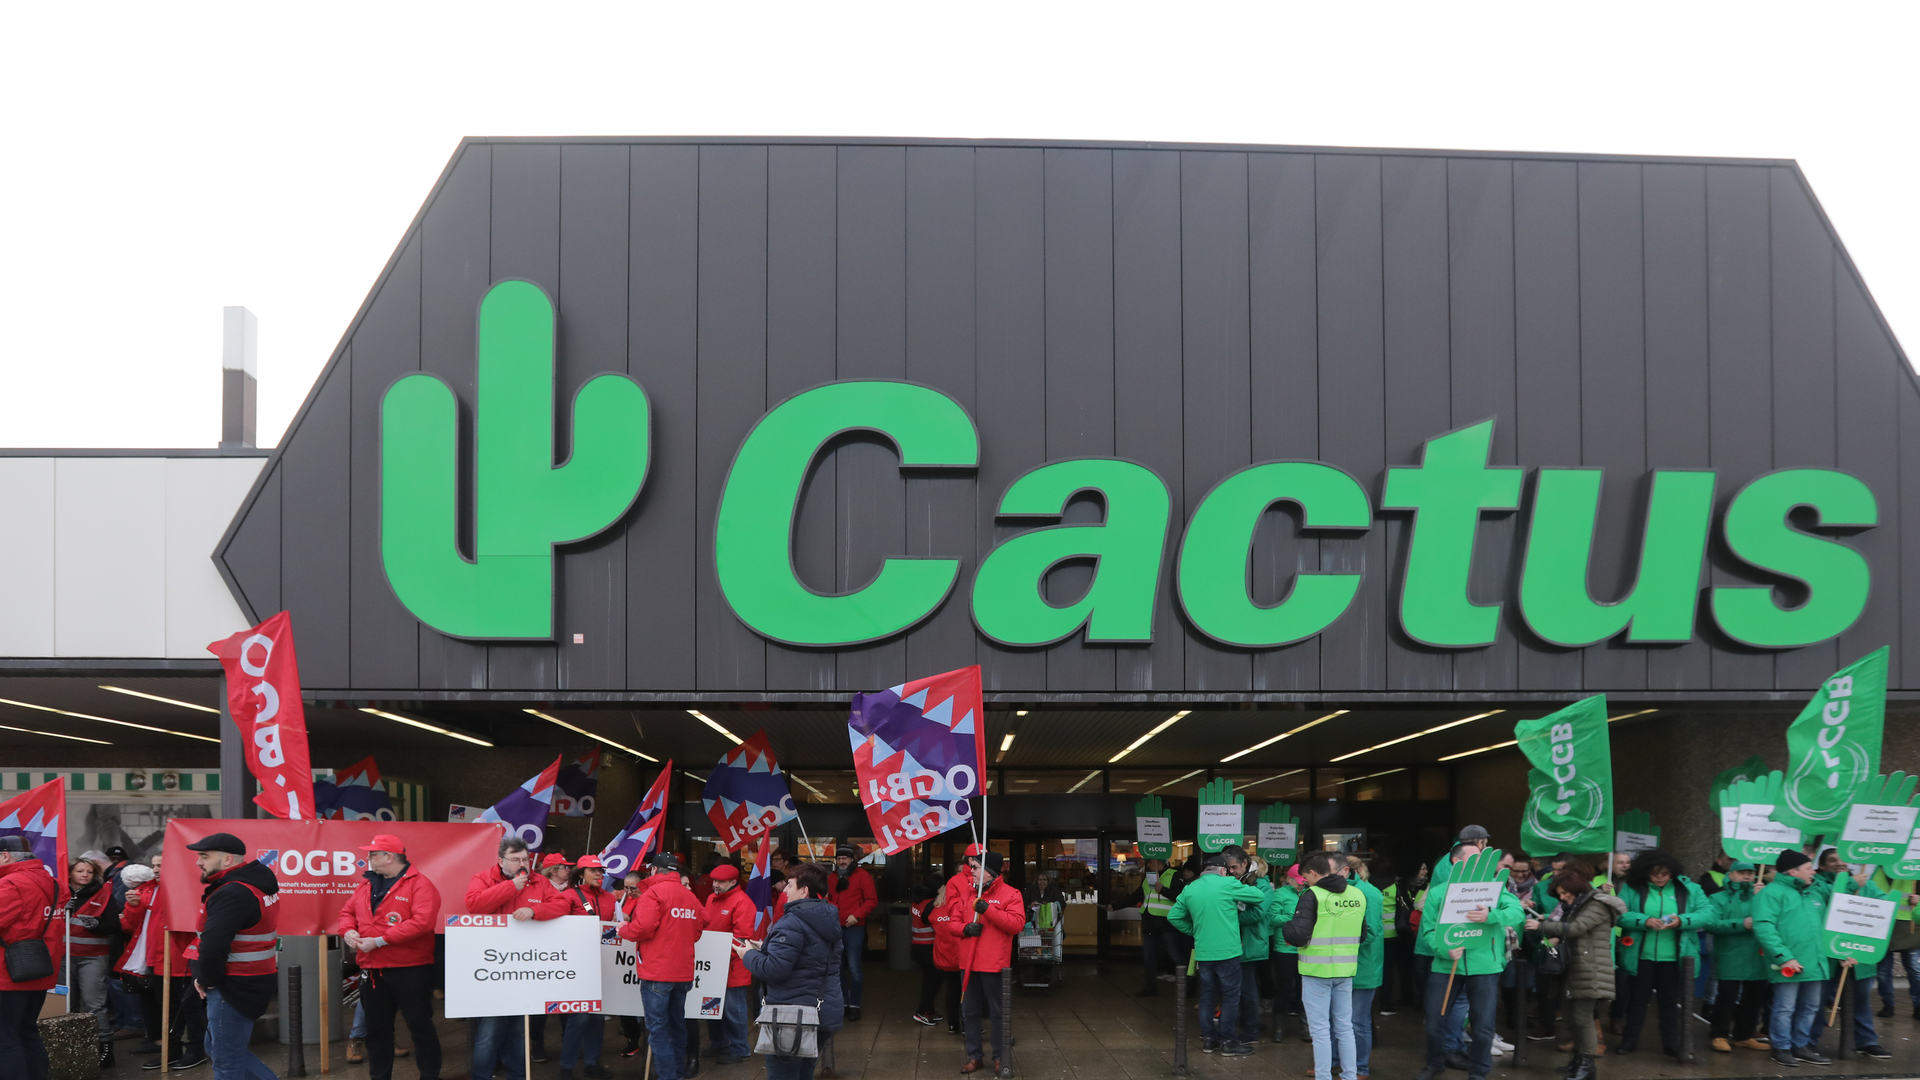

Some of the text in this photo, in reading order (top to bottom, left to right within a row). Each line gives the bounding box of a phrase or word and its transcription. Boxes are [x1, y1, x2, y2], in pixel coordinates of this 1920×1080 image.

[713, 380, 1879, 647] Cactus
[1339, 900, 1361, 908] LCGB
[1458, 929, 1483, 938] LCGB
[484, 949, 568, 964] Syndicat
[474, 968, 577, 981] Commerce
